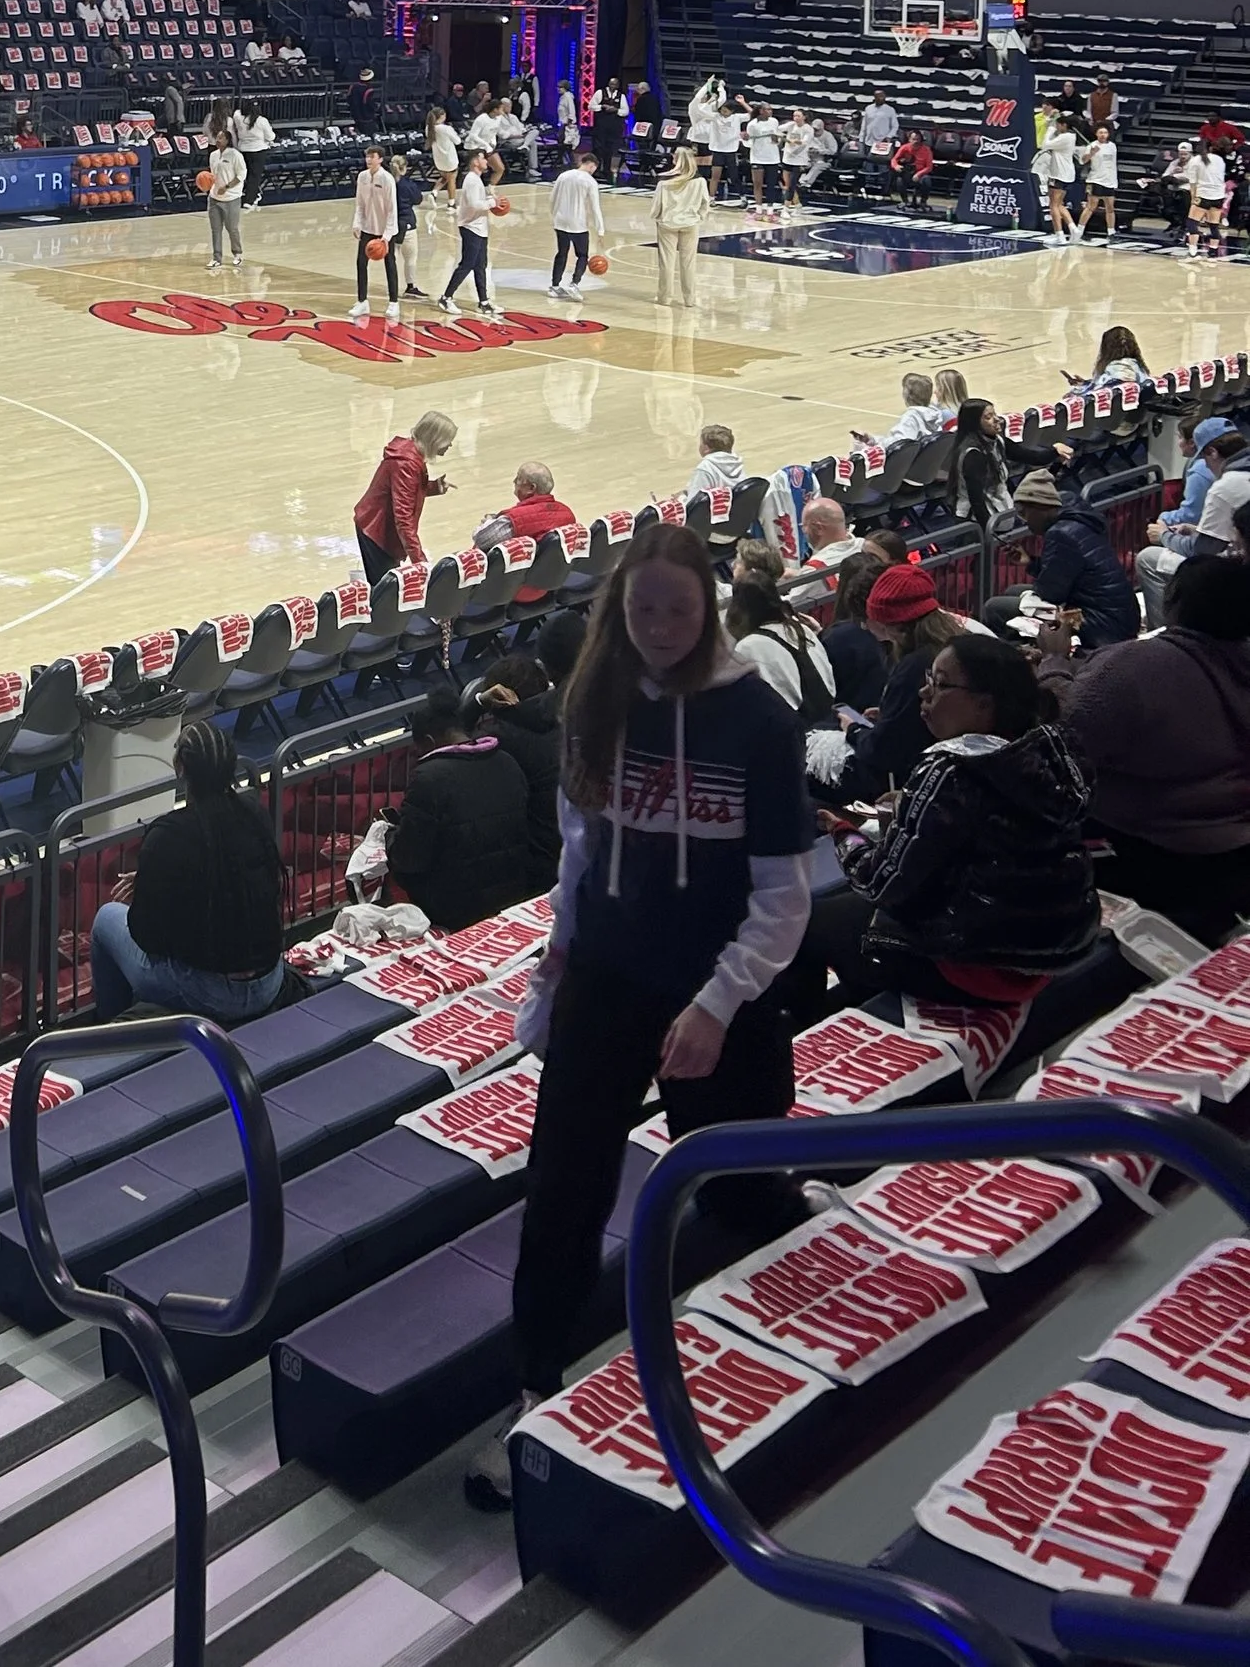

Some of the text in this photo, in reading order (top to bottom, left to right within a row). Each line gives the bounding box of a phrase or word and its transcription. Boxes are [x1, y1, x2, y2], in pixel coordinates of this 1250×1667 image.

[983, 143, 1015, 153] SONIC
[35, 169, 114, 191] TRCK
[976, 185, 1015, 197] PEARL
[970, 203, 1021, 216] RESORT
[974, 194, 1017, 207] RIVER
[89, 293, 609, 363] Ole Miss
[850, 329, 982, 359] CRADDOCK
[913, 340, 998, 361] COURT
[800, 1034, 944, 1104] DICTATE
[910, 1162, 1083, 1260] DICTATE
[719, 1236, 872, 1330] DISRUPT
[771, 1252, 967, 1371] DICTATE
[1031, 1411, 1228, 1598] DICTATE
